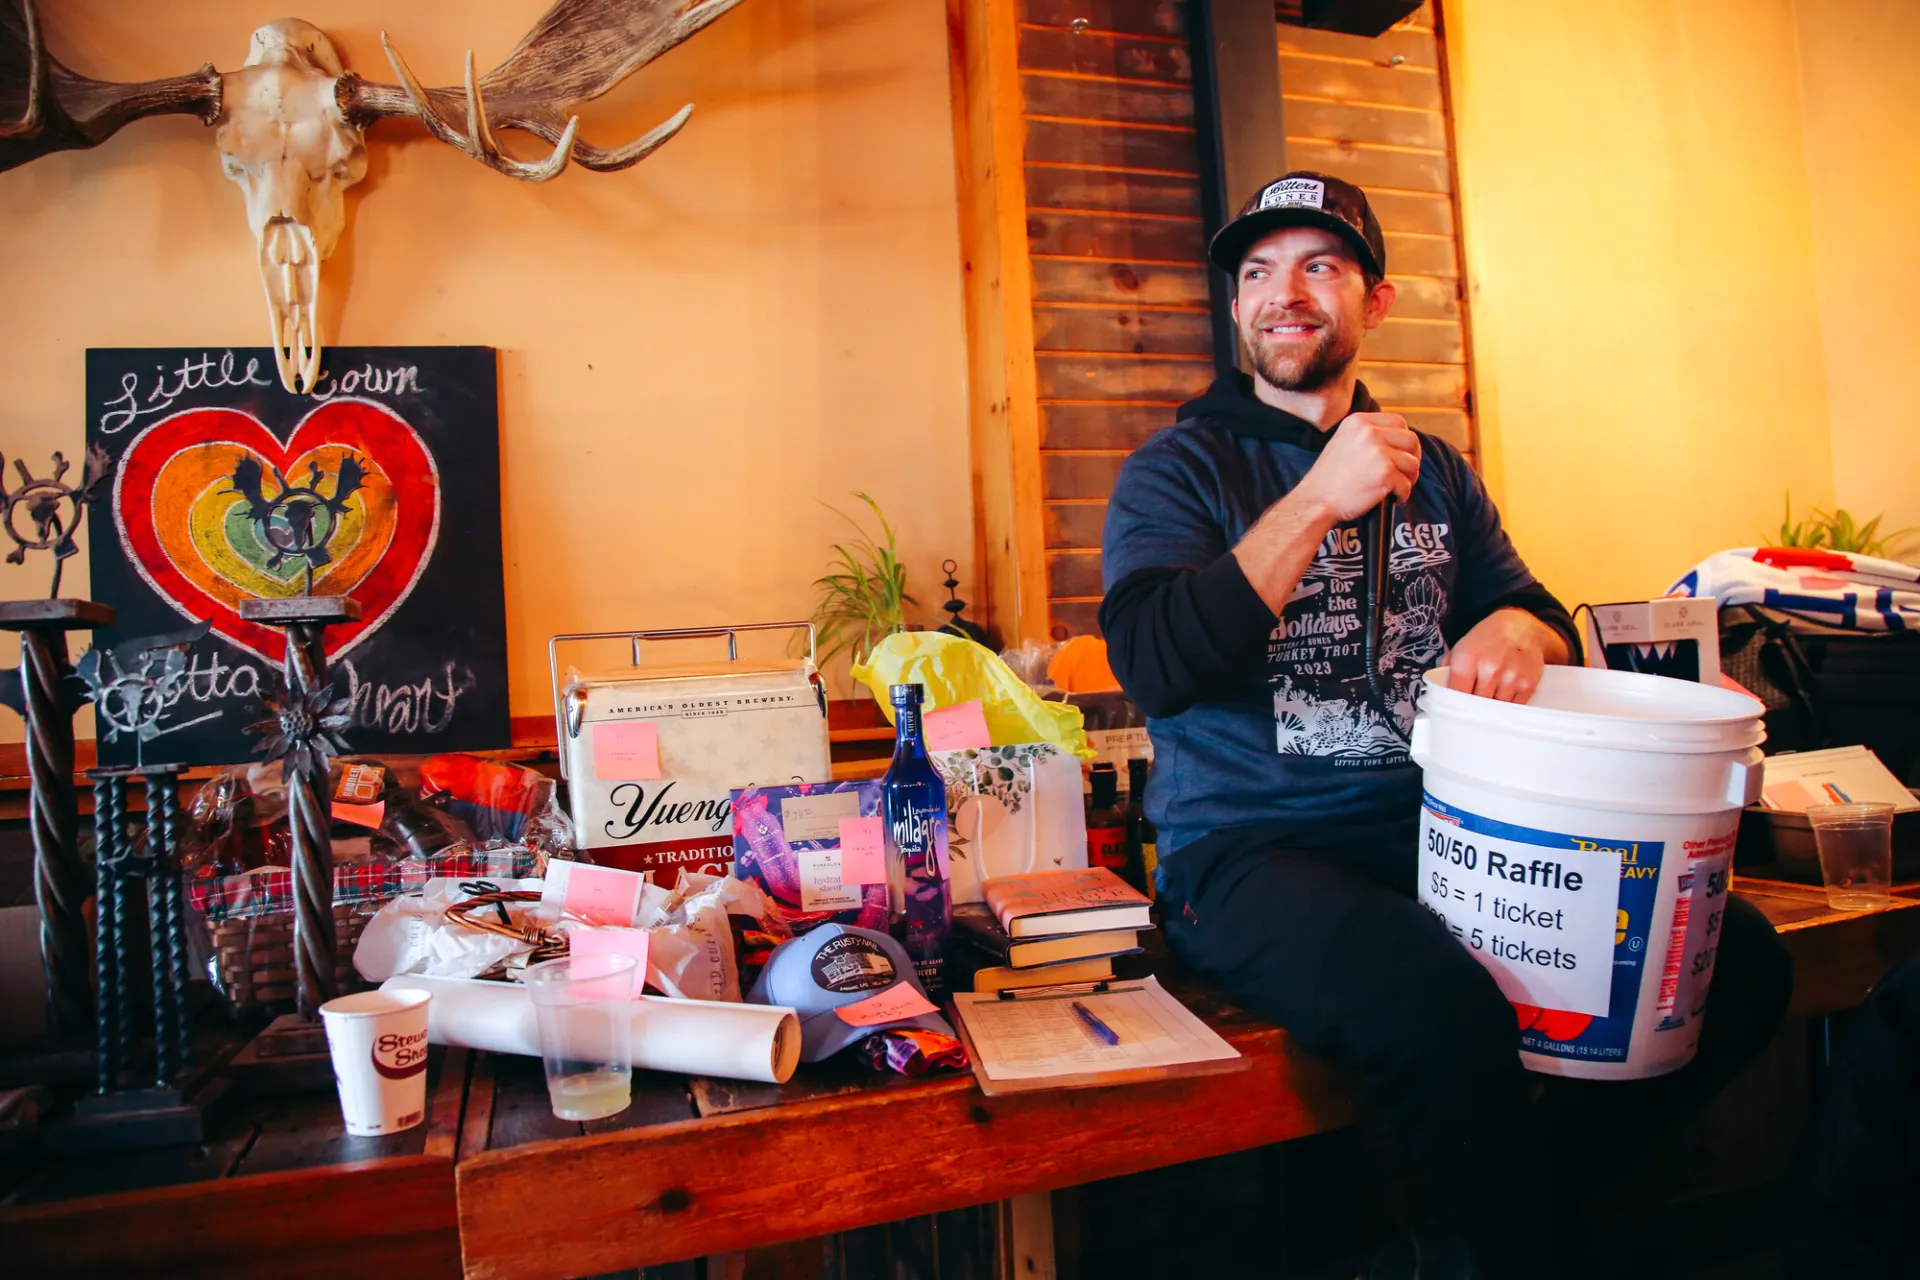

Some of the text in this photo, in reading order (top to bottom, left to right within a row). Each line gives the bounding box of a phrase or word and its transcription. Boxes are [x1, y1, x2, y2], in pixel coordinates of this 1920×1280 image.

[100, 350, 273, 433] Little
[1391, 522, 1449, 549] EEP
[1330, 578, 1354, 594] for
[1328, 595, 1357, 612] the
[1267, 642, 1362, 664] TURKEY TROT
[1294, 661, 1332, 675] 2023
[608, 703, 674, 714] AMERICA'S
[682, 700, 729, 709] OLDEST
[604, 781, 732, 839] Yueng
[893, 799, 942, 877] milagro
[655, 845, 734, 864] TRADITIO
[1428, 827, 1583, 891] 50/50 Raffle
[1620, 866, 1657, 879] EAVY
[1431, 871, 1564, 931] $5 = 1 ticket
[815, 937, 880, 961] THE RUSTY NAIL
[1470, 928, 1483, 950] 5
[1491, 935, 1577, 970] tickets
[916, 968, 937, 976] ILVER
[1522, 1036, 1536, 1047] NET
[1543, 1041, 1576, 1054] GALLONS
